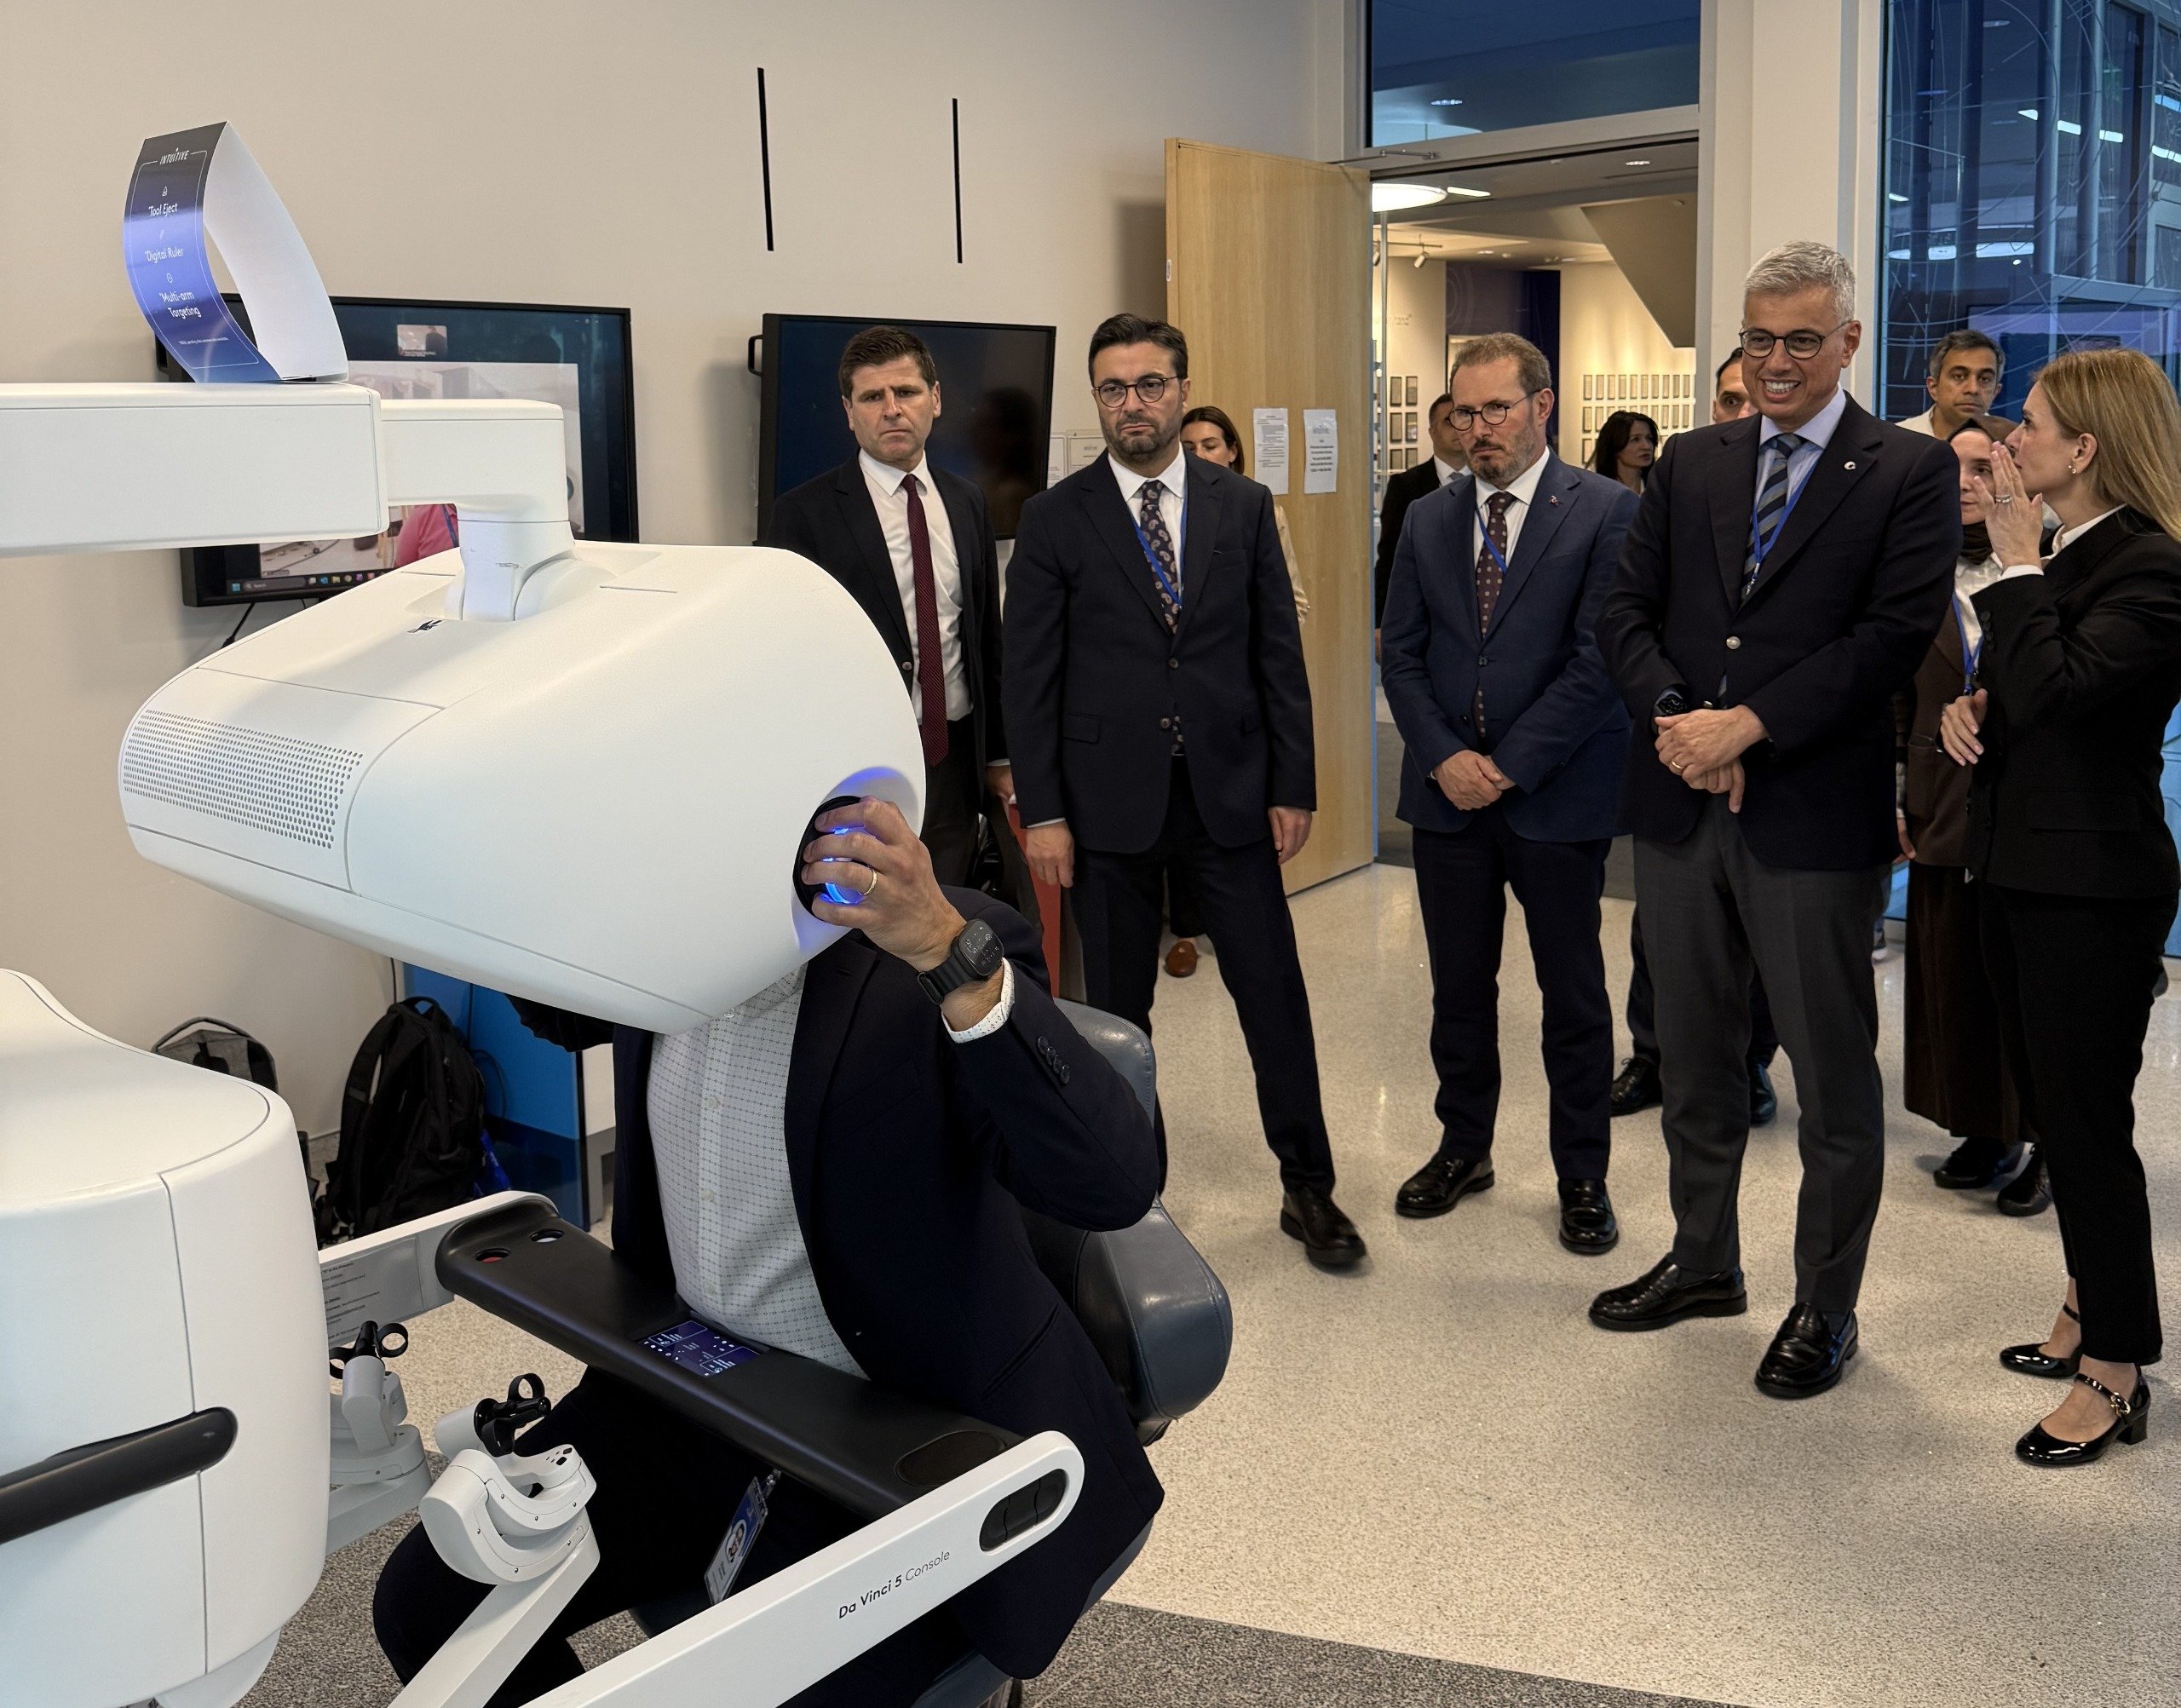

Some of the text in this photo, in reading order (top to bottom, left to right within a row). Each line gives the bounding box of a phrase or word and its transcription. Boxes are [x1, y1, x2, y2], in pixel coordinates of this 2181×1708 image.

[160, 147, 189, 164] INTUITIVE
[149, 203, 178, 217] Tool Eject
[146, 246, 184, 263] Digital Ruler
[160, 290, 195, 302] Multi-arm
[168, 306, 202, 319] Targeting
[838, 1551, 950, 1619] Da Vinci 5 Console
